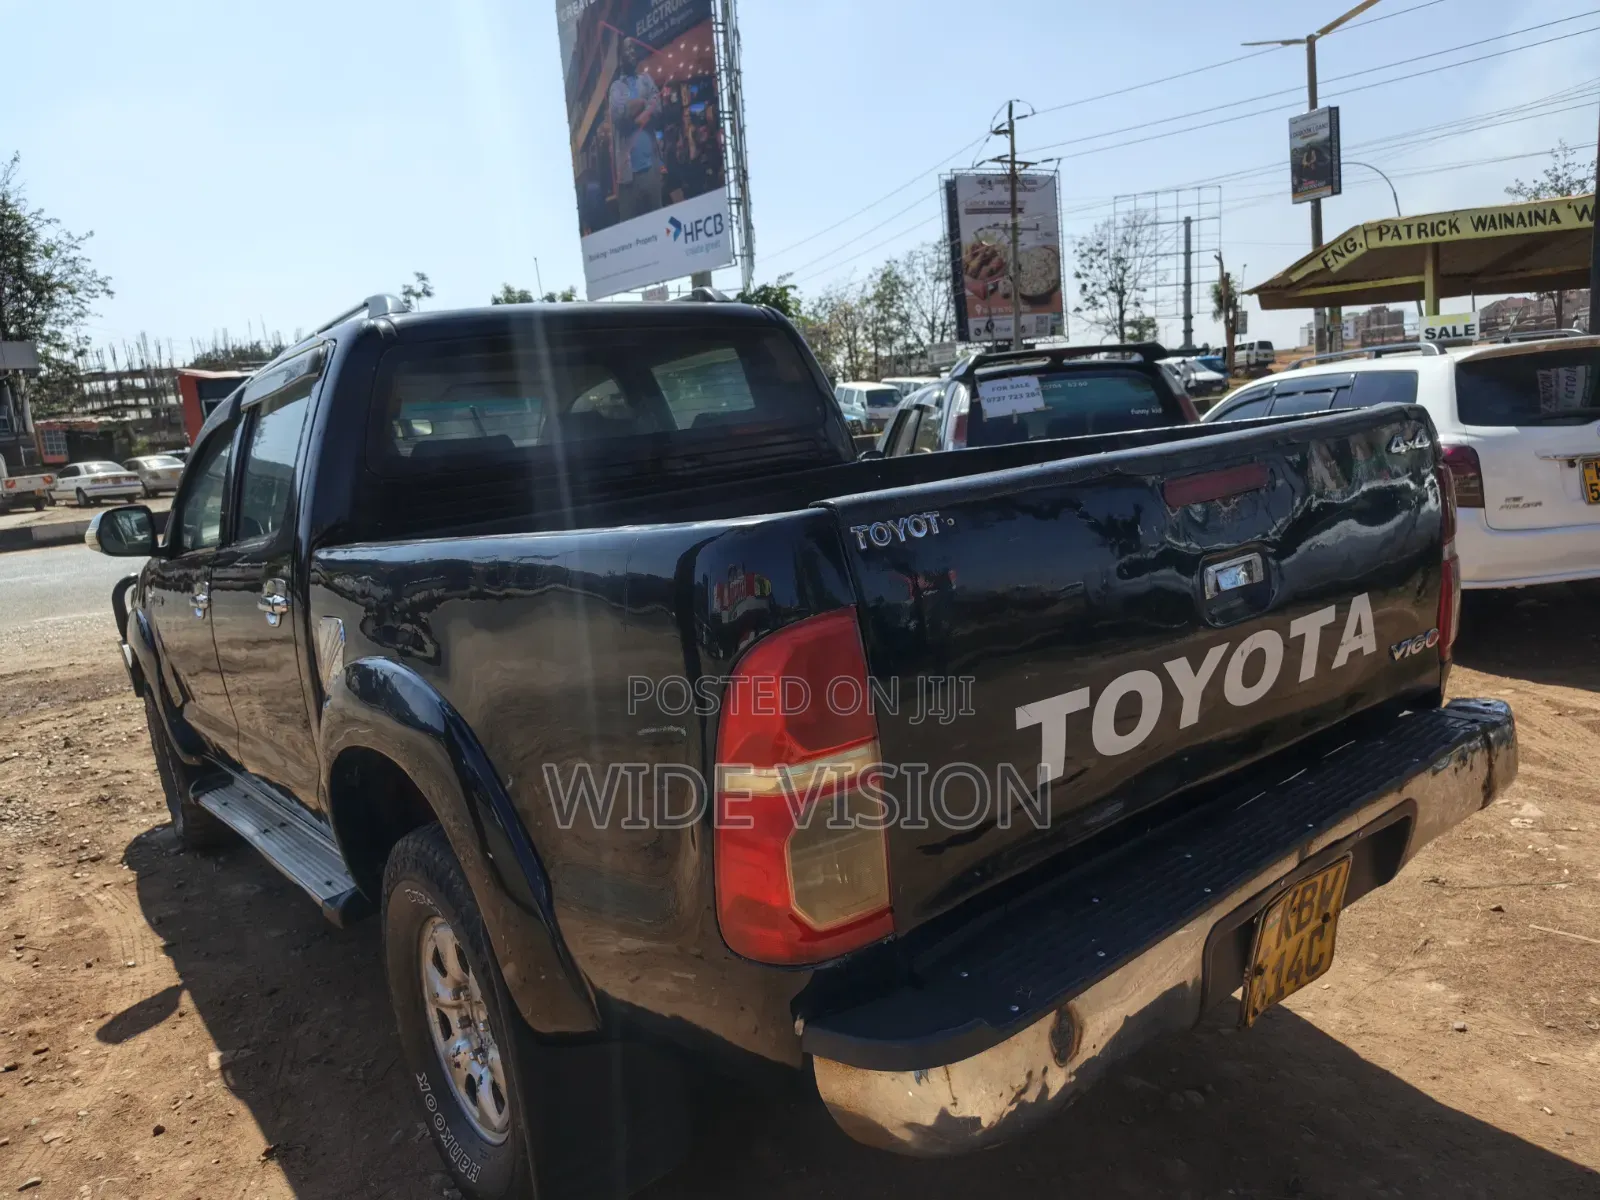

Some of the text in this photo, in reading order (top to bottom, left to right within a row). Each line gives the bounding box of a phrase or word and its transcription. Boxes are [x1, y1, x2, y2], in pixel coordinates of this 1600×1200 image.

[684, 213, 724, 244] HFCB
[1321, 237, 1364, 271] ENG.
[1377, 214, 1461, 242] PATRICK
[1470, 207, 1562, 232] WAINAINA
[1424, 323, 1476, 340] SALE
[992, 382, 1030, 392] FOR SALE
[1131, 406, 1163, 416] funny kid
[1390, 628, 1440, 661] VIGO
[1015, 592, 1377, 785] TOYOTA
